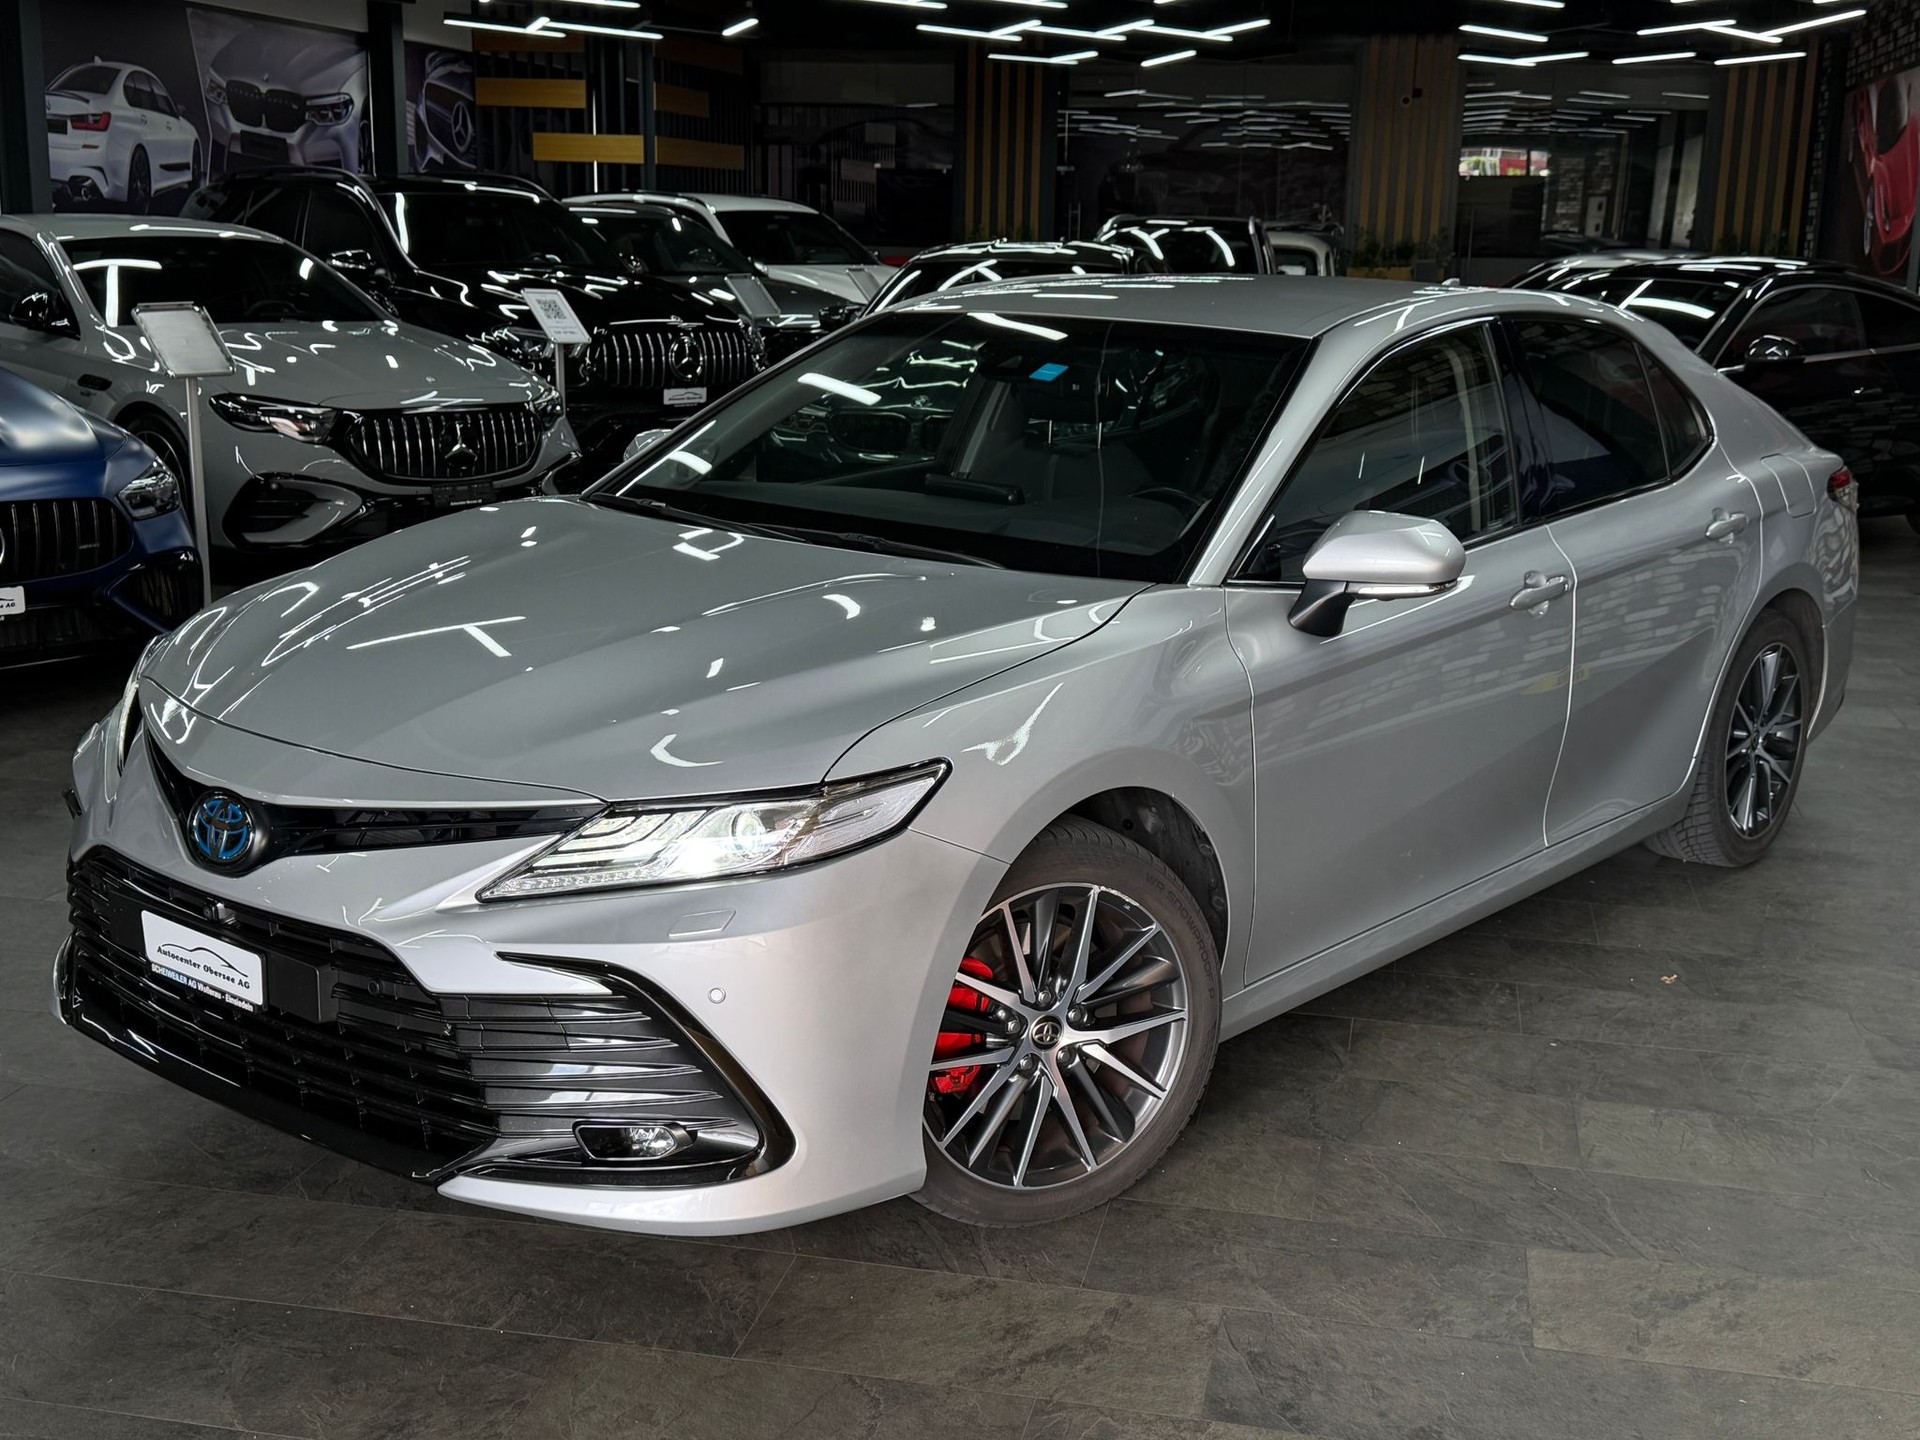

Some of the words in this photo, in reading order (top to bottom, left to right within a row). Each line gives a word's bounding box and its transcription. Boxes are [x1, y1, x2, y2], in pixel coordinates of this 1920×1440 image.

[157, 946, 201, 970] Autocenter
[203, 964, 235, 984] Obersee
[237, 978, 250, 990] AG
